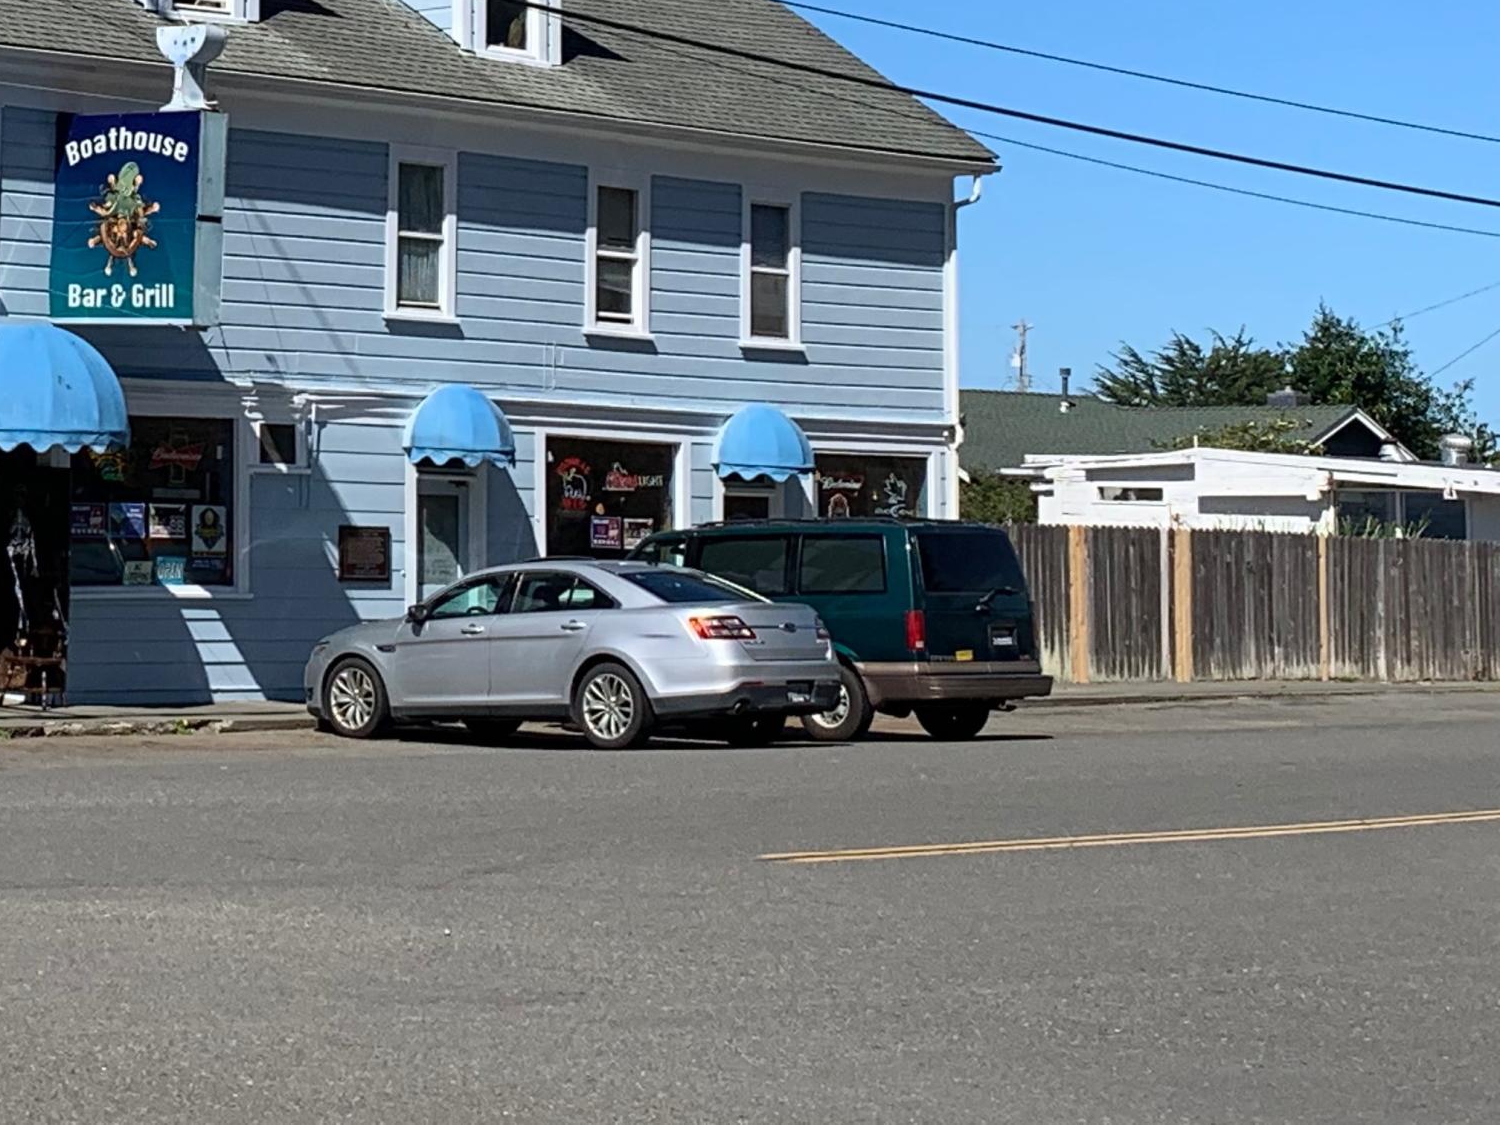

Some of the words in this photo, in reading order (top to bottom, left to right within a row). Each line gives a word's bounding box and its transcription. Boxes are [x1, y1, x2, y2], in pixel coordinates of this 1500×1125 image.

[65, 127, 189, 166] Boathouse
[68, 284, 106, 307] Bar
[111, 284, 125, 307] &
[132, 284, 174, 308] Grill
